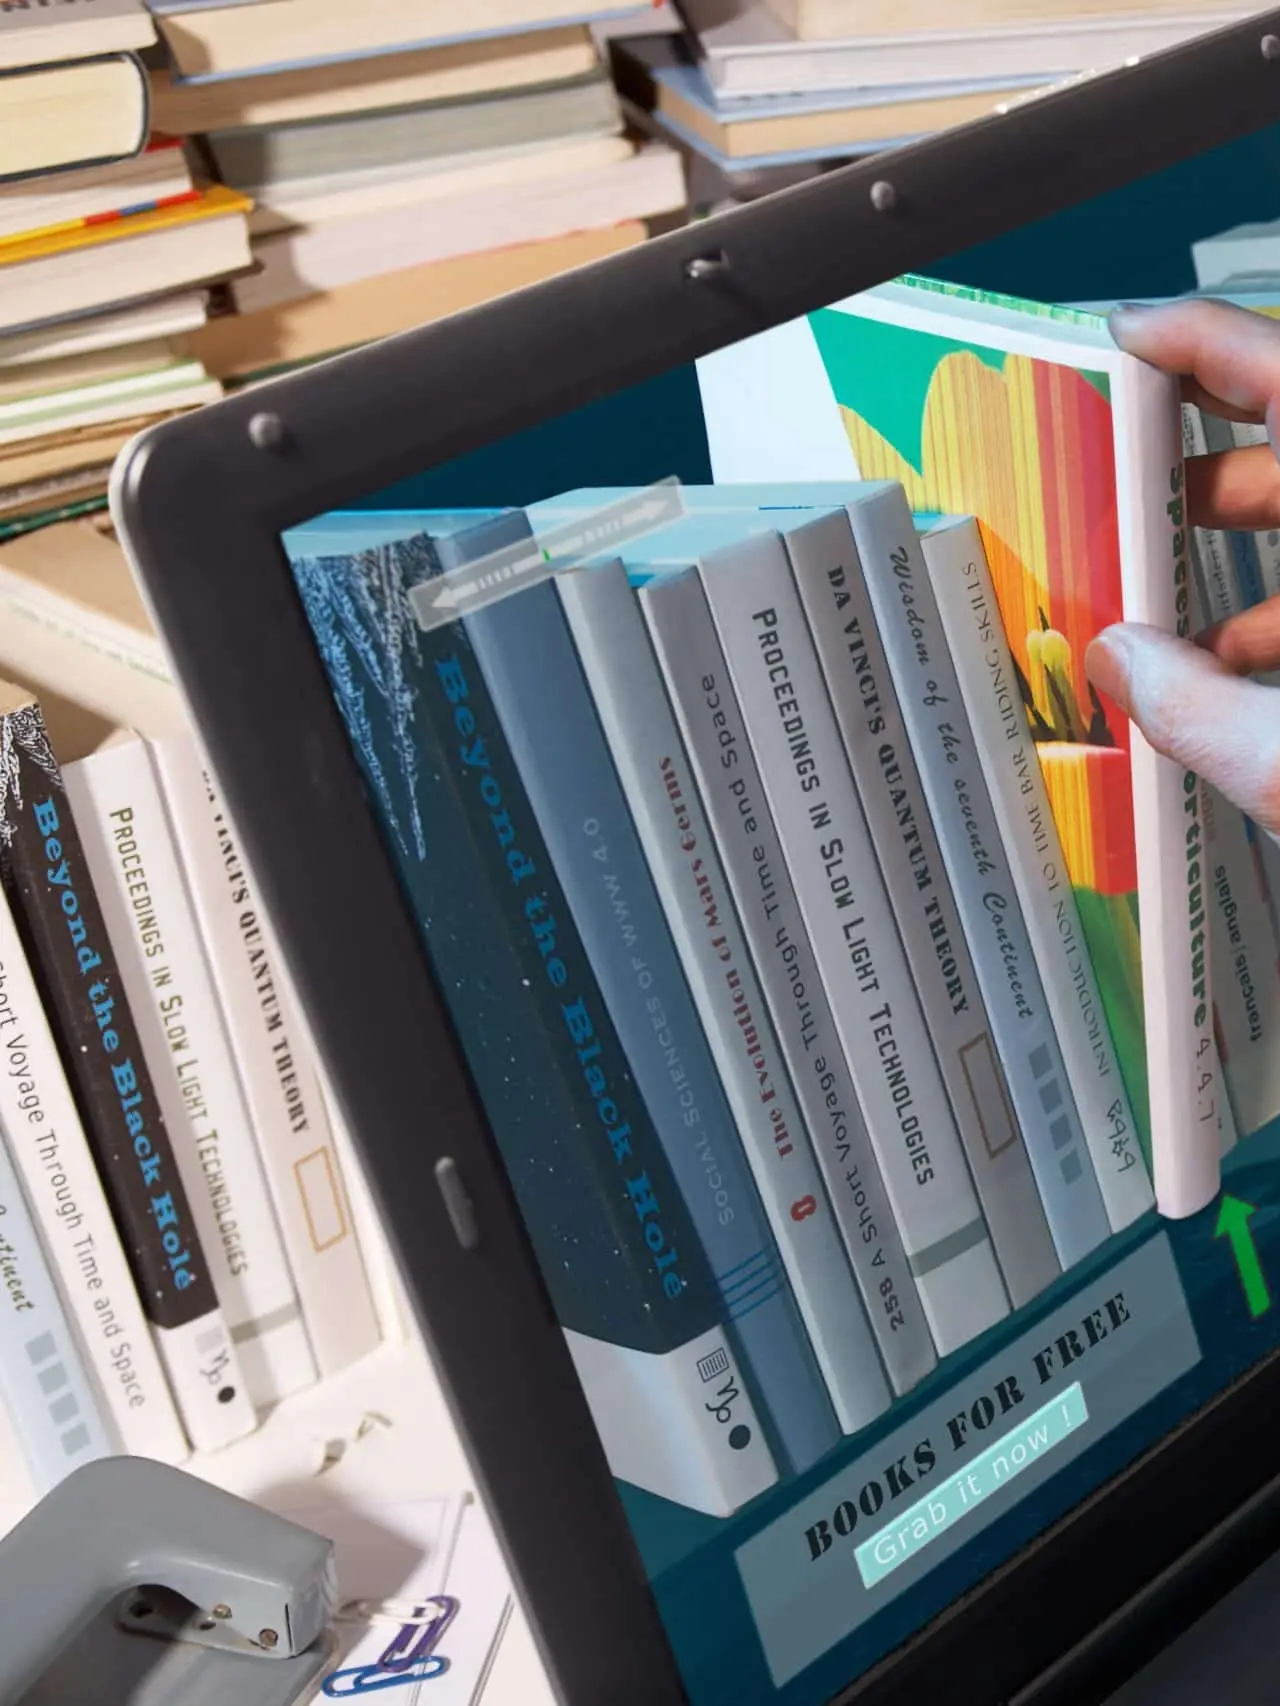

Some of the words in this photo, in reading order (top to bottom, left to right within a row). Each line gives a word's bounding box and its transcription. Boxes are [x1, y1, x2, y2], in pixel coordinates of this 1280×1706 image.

[962, 560, 995, 644] SKILLS
[702, 673, 741, 769] Space
[985, 647, 1021, 741] RIDING
[825, 564, 852, 610] DA
[842, 615, 888, 736] VINCI'S
[877, 742, 936, 893] QUANTUM
[922, 896, 973, 1018] THEORY
[887, 546, 931, 667] Wisdom
[921, 680, 946, 708] of
[936, 722, 961, 766] the
[953, 773, 994, 878] seventh
[982, 891, 1034, 1020] Continent
[1013, 750, 1035, 797] BAR
[1166, 461, 1191, 641] Spaces
[1183, 770, 1208, 1028] orticulture
[583, 817, 606, 863] 4.0
[660, 756, 696, 852] Germs
[728, 778, 757, 834] and
[1026, 802, 1051, 856] TIME
[109, 807, 165, 958] PROCEEDINGS
[603, 874, 639, 946] WWW
[690, 857, 721, 929] Mars
[752, 843, 776, 919] Time
[752, 606, 821, 793] PROCEEDINGS
[806, 801, 832, 831] IN
[820, 834, 857, 913] SLOW
[840, 915, 882, 992] LIGHT
[866, 1003, 935, 1187] TECHNOLOGIES
[1041, 862, 1061, 895] TO
[1214, 864, 1242, 945] anglais
[151, 966, 173, 988] IN
[436, 657, 536, 886] Beyond
[523, 893, 570, 988] the
[562, 996, 632, 1166] Black
[626, 1171, 684, 1298] Hole
[631, 956, 652, 990] OF
[711, 936, 732, 962] of
[775, 928, 819, 1052] Through
[1047, 898, 1112, 1078] INTRODUCTION
[33, 798, 103, 976] Beyond
[87, 980, 121, 1053] the
[111, 1058, 162, 1187] Black
[149, 1192, 193, 1292] Hole
[159, 995, 191, 1053] SLOW
[239, 911, 283, 1029] QUANTUM
[268, 1039, 310, 1135] THEORY
[651, 997, 700, 1127] SCIENCES
[724, 969, 776, 1105] Evolution
[175, 1056, 209, 1122] LIGHT
[769, 1107, 795, 1161] The
[811, 1049, 853, 1165] Voyage
[6, 1033, 44, 1124] Voyage
[33, 1129, 84, 1231] Through
[72, 1234, 104, 1291] Time
[93, 1297, 124, 1339] and
[109, 1343, 147, 1410] Space
[195, 1128, 249, 1278] TECHNOLOGIES
[695, 1134, 734, 1227] SOCIAL
[843, 1161, 879, 1246] Short
[870, 1248, 886, 1268] A
[803, 1440, 936, 1562] BOOKS
[945, 1372, 1026, 1454] FOR
[1032, 1292, 1133, 1386] FREE
[873, 1502, 947, 1569] Grab
[957, 1474, 983, 1505] it
[991, 1425, 1050, 1477] now
